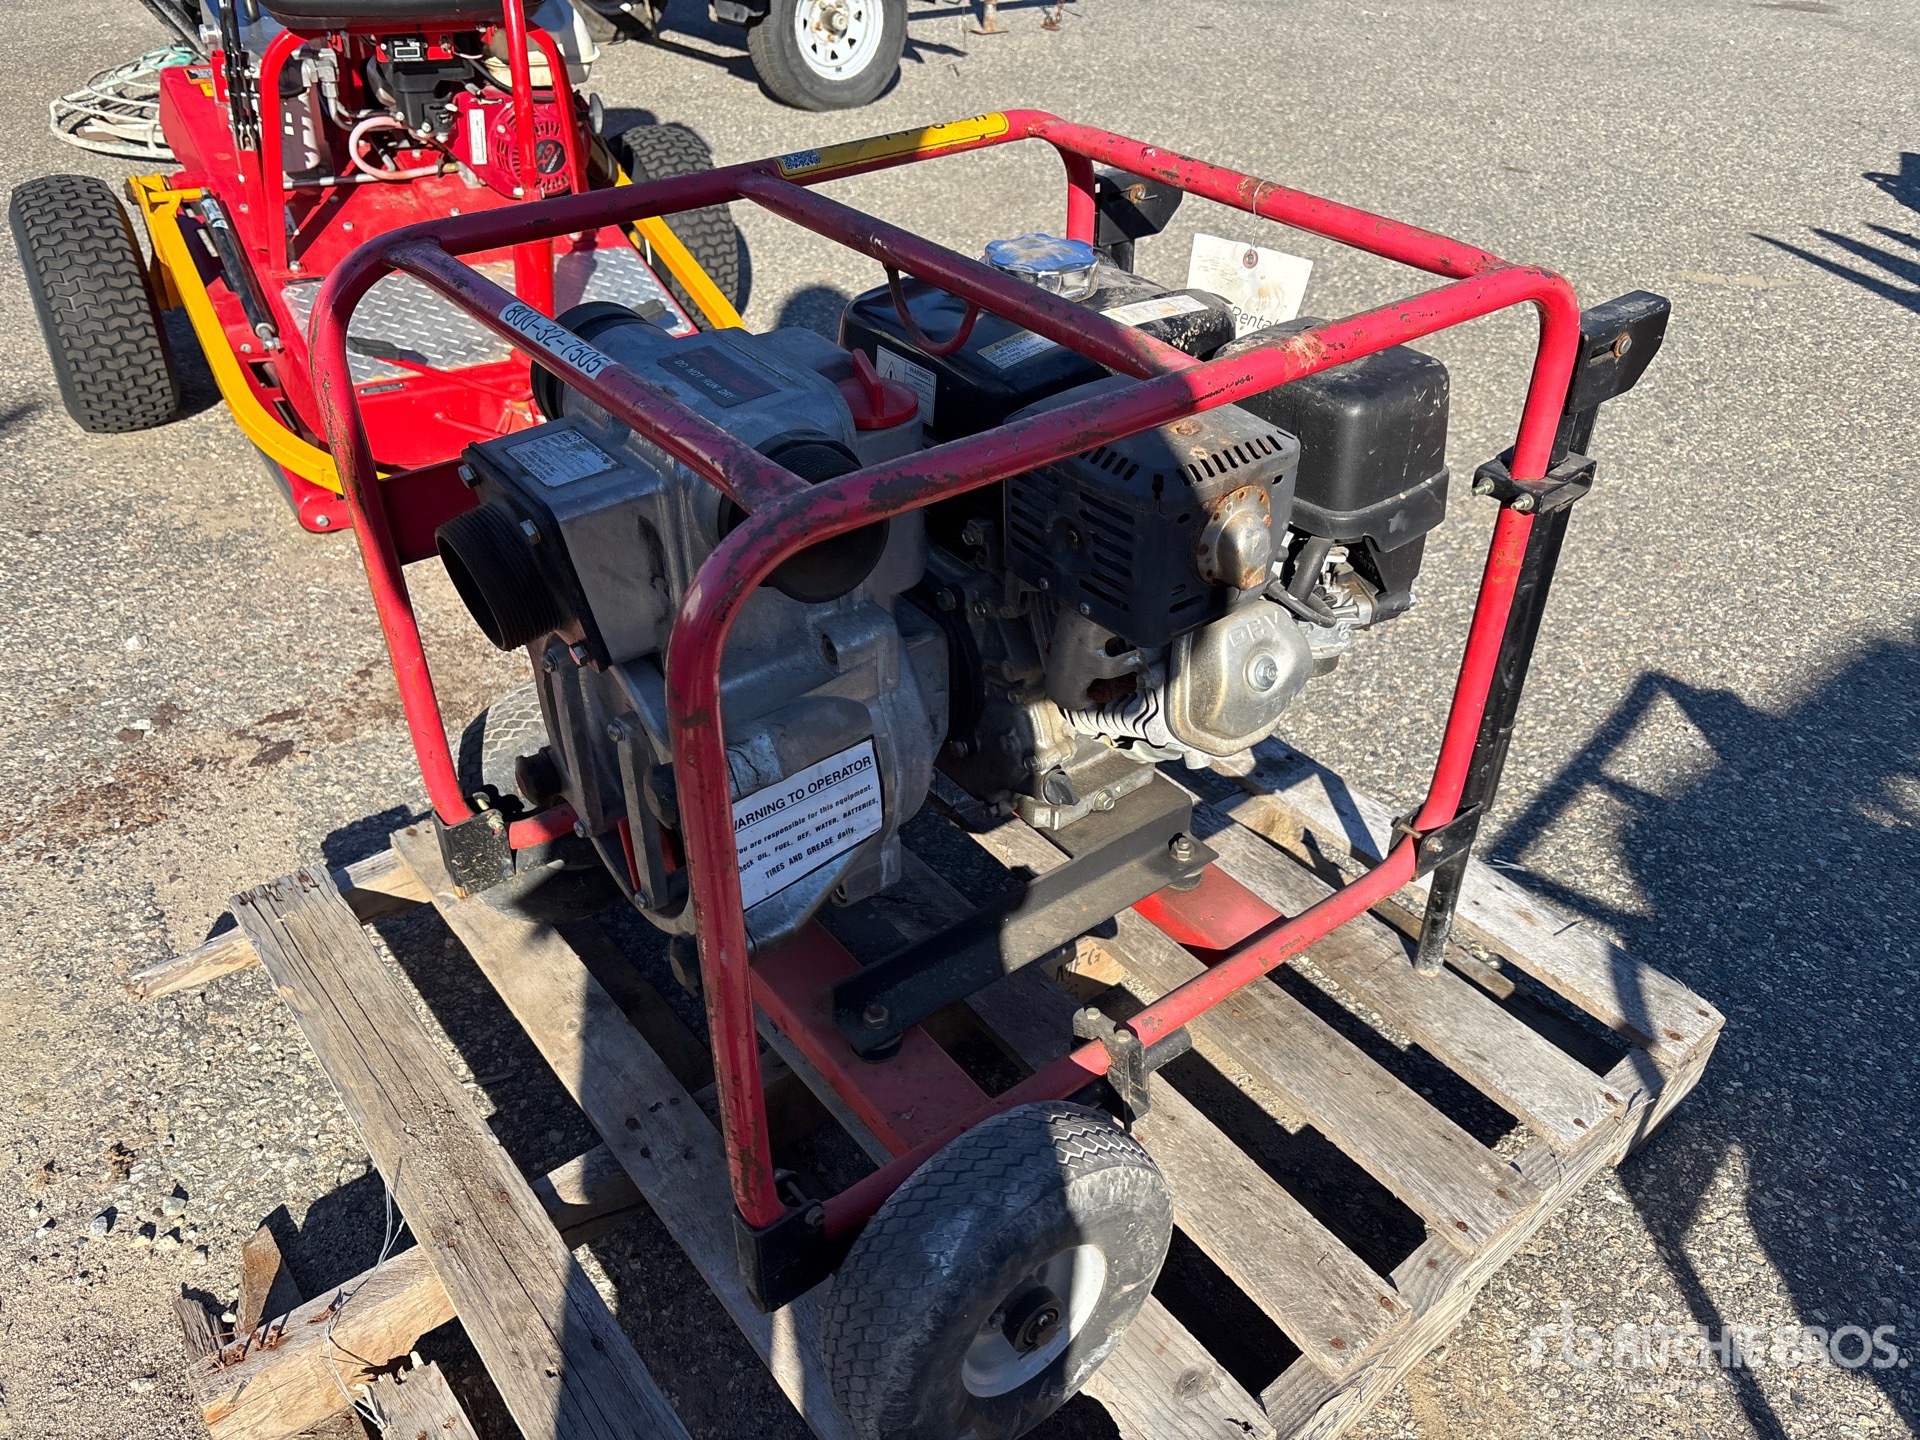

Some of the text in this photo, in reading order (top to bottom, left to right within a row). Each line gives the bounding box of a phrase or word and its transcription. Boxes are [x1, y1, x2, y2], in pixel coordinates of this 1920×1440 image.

[505, 305, 610, 374] 800-32-7505
[674, 359, 737, 399] DO NOT RUN DRY
[1228, 610, 1278, 647] OHV
[734, 756, 872, 831] ARNING TO OPERATOR
[750, 839, 762, 848] are
[764, 816, 806, 842] responsible
[807, 811, 818, 820] for
[819, 804, 834, 814] this
[835, 784, 874, 807] equipment.
[739, 859, 755, 873] heck
[764, 862, 785, 879] TIRES
[788, 853, 803, 866] AND
[806, 836, 834, 856] GREASE
[837, 826, 857, 840] daily.
